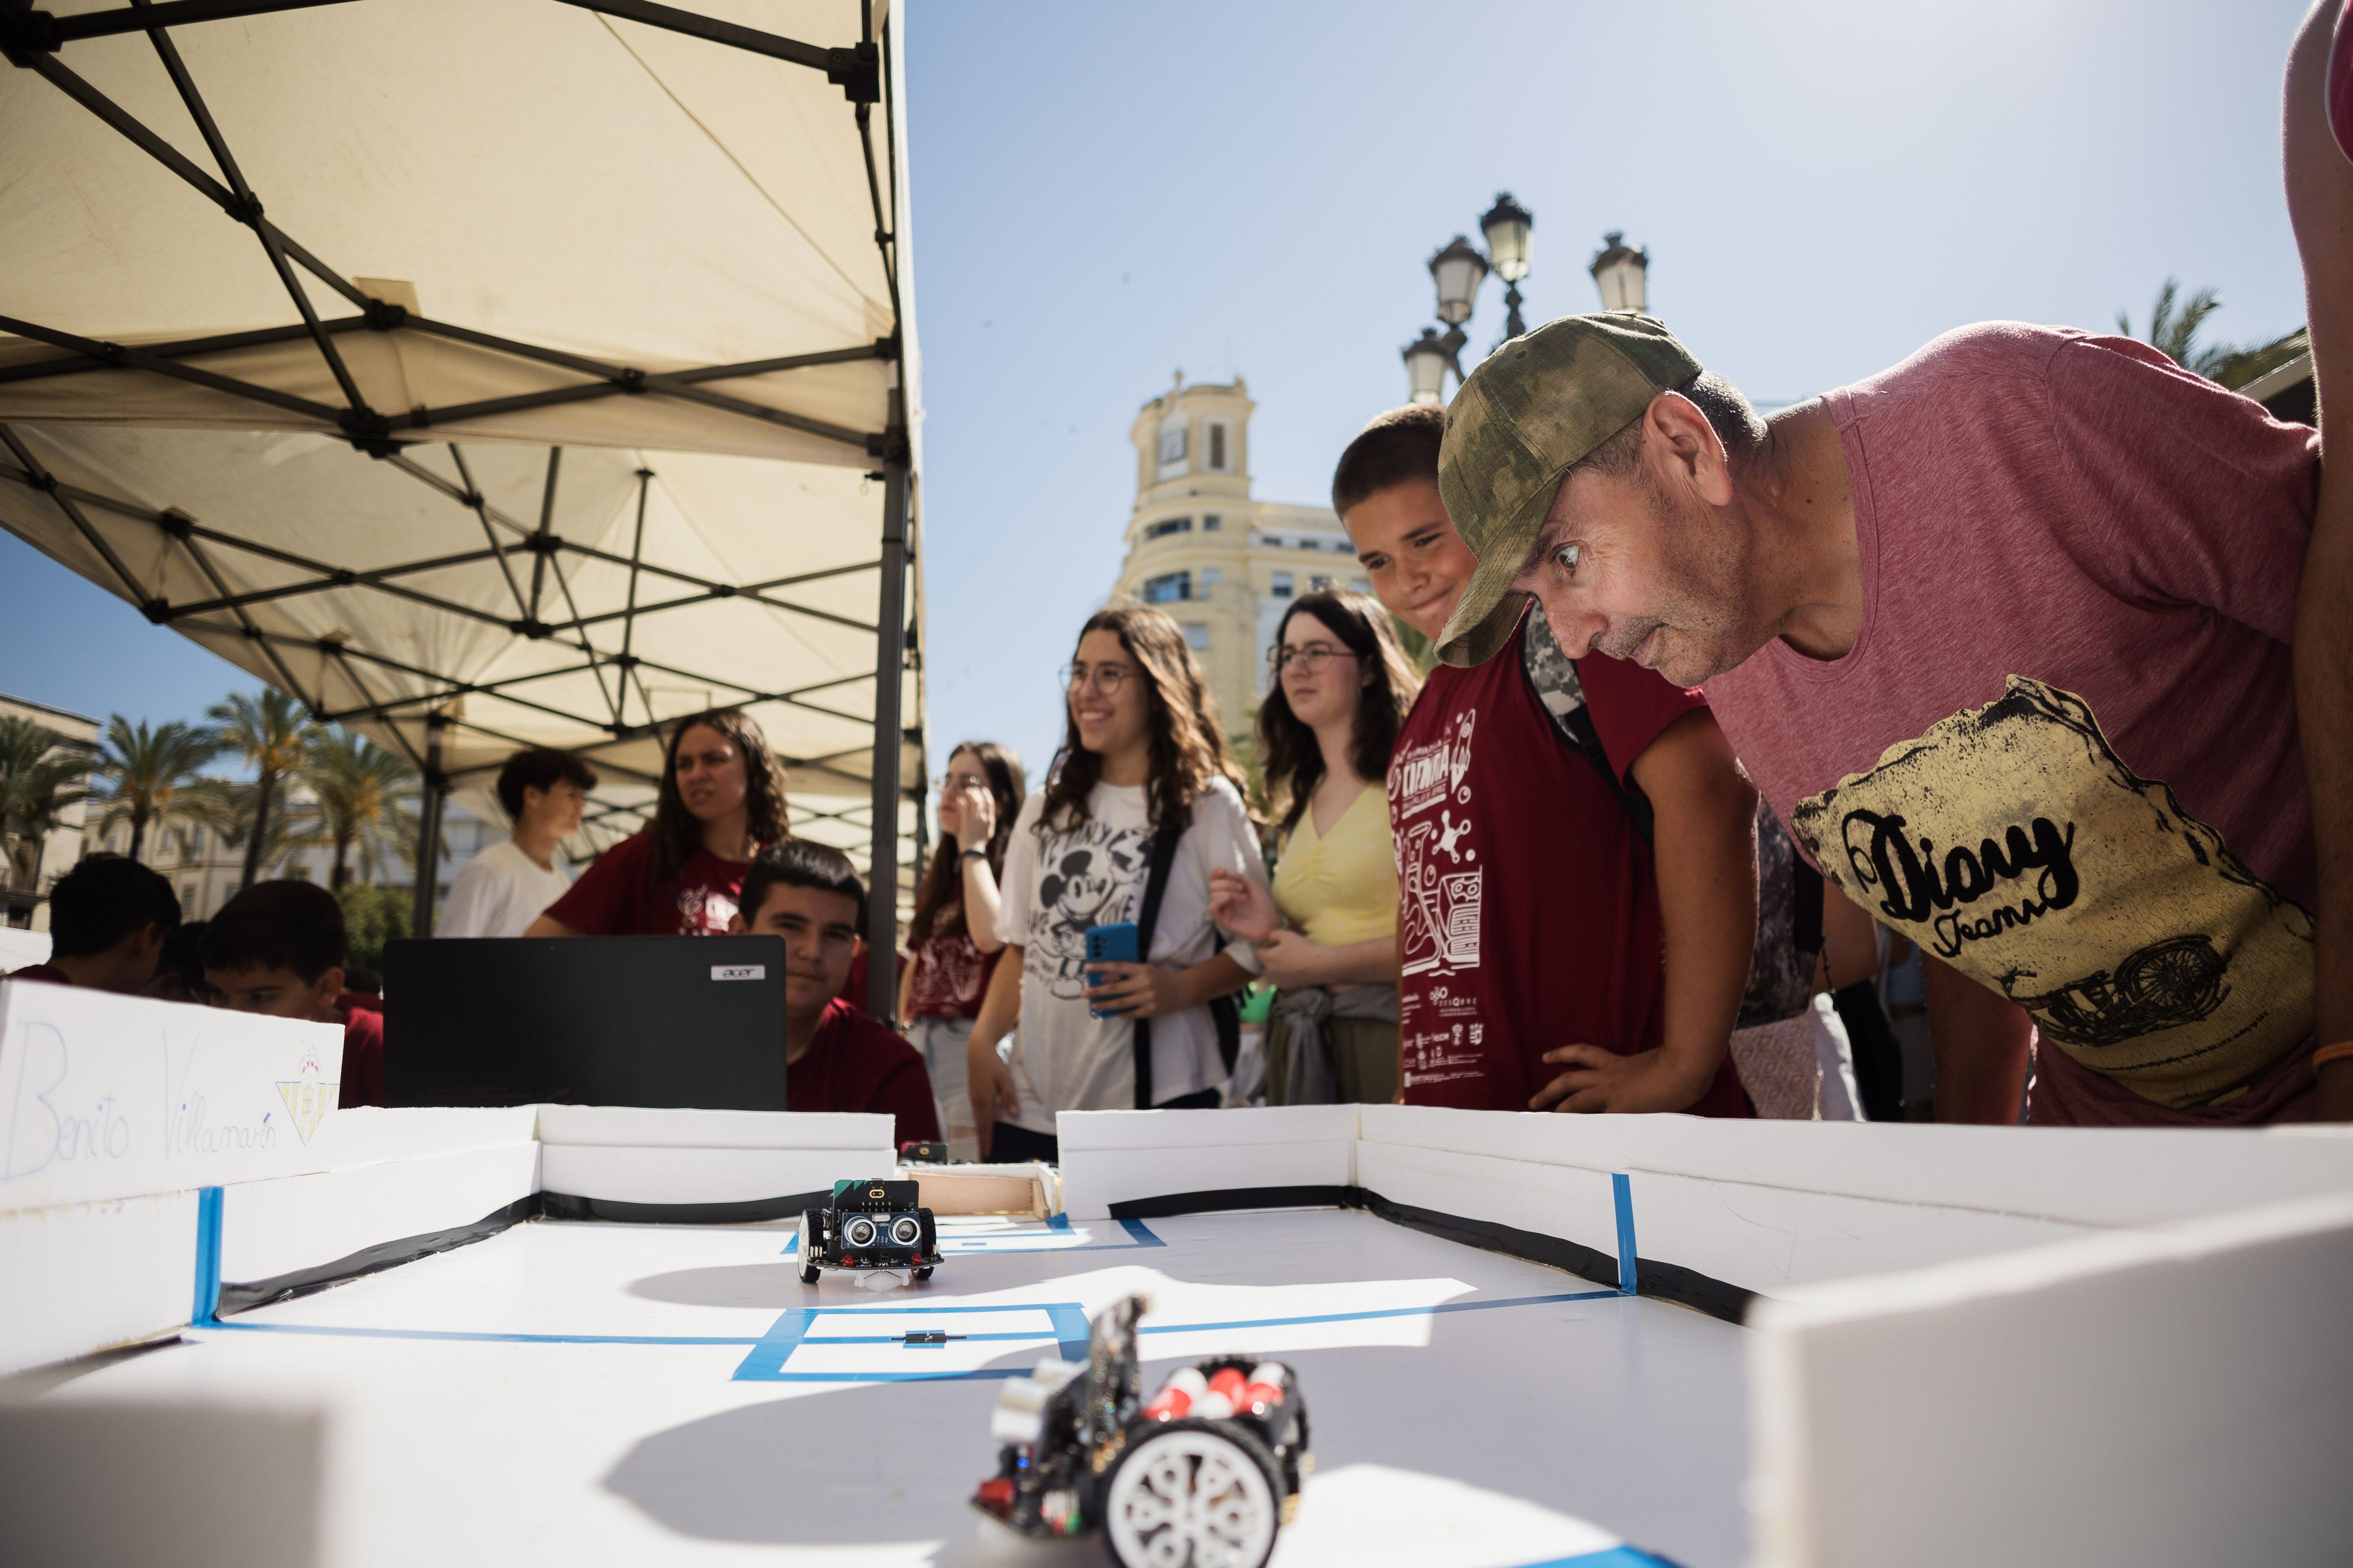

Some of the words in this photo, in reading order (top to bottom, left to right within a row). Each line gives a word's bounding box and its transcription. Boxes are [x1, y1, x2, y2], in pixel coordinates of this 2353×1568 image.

[723, 969, 755, 978] acer
[2, 1021, 130, 1181] Benito
[163, 1028, 276, 1160] Villamarín
